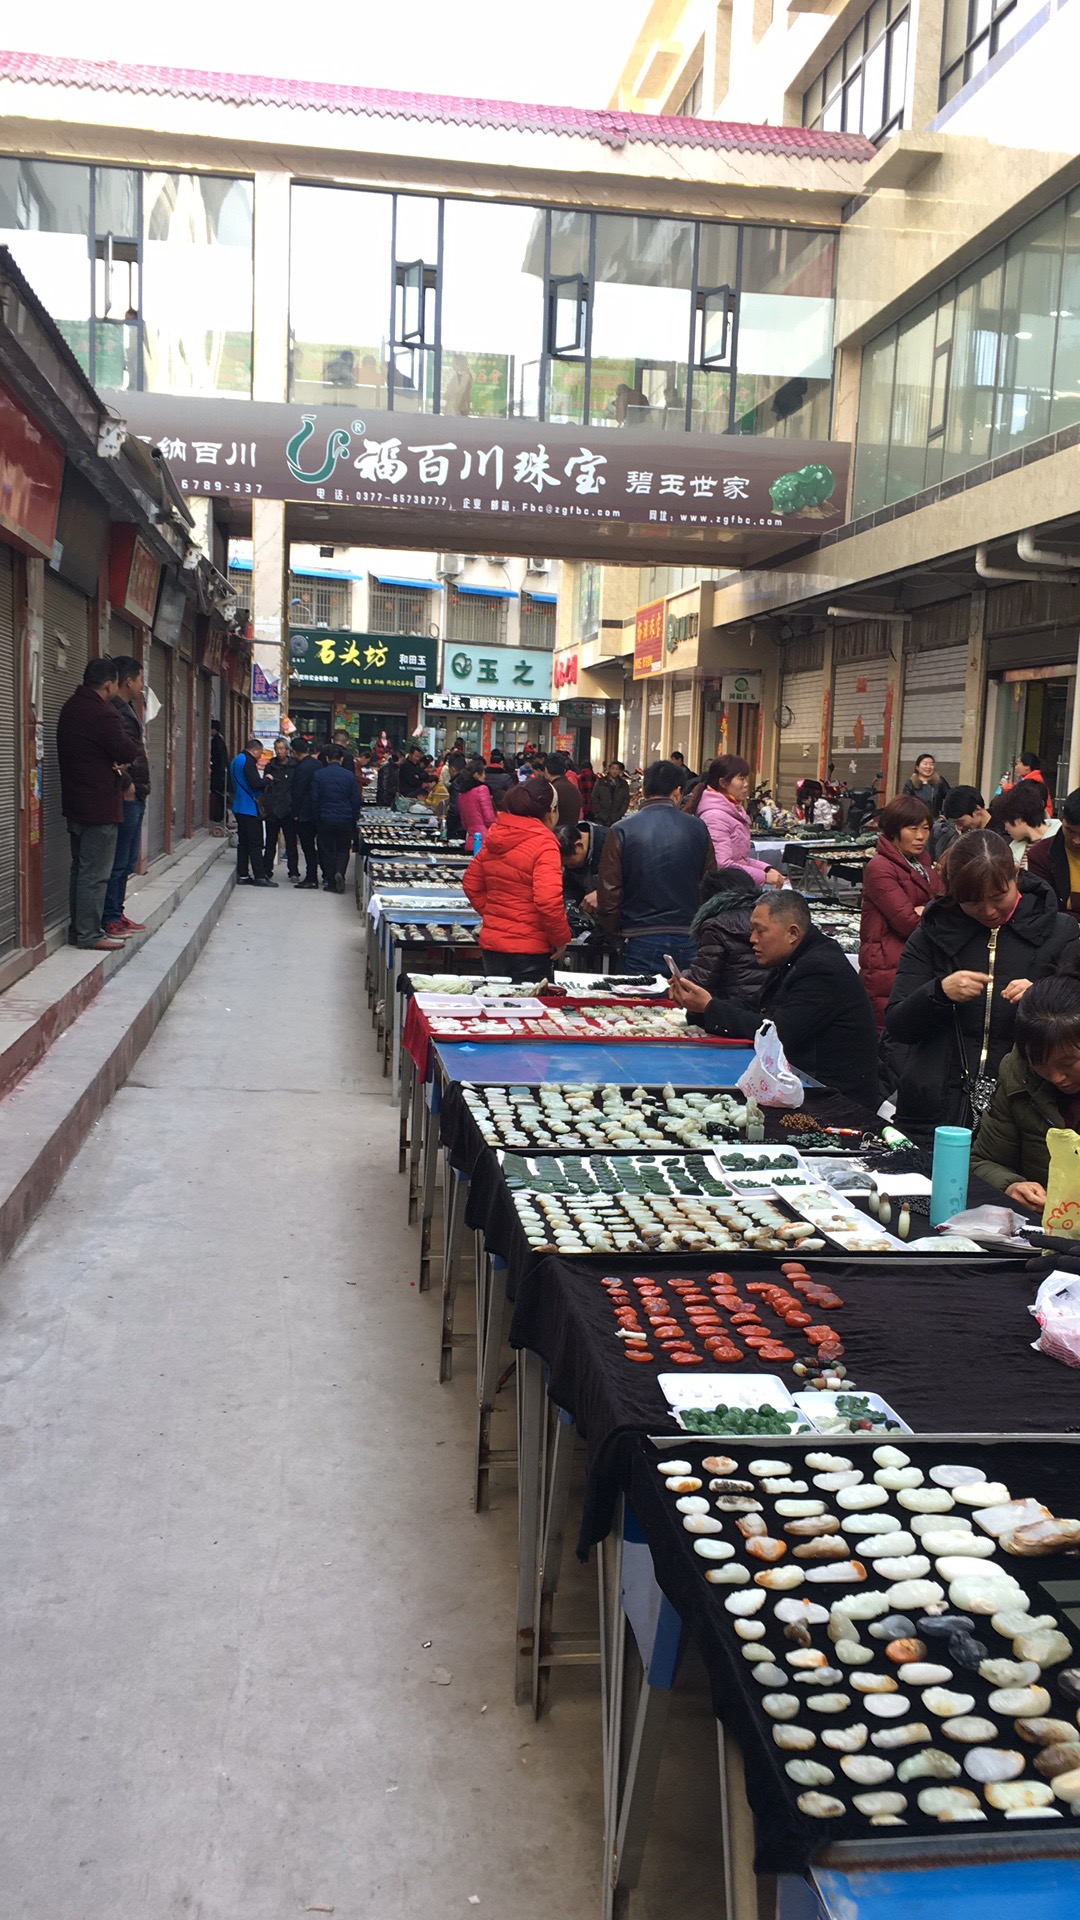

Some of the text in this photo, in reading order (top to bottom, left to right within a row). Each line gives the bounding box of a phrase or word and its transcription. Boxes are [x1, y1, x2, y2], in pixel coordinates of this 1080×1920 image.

[138, 436, 257, 468] 纳百川
[354, 438, 607, 495] 福百川珠宝
[625, 471, 750, 500] 碧玉世家
[314, 639, 389, 671] 石头坊
[398, 653, 427, 666] 和田玉
